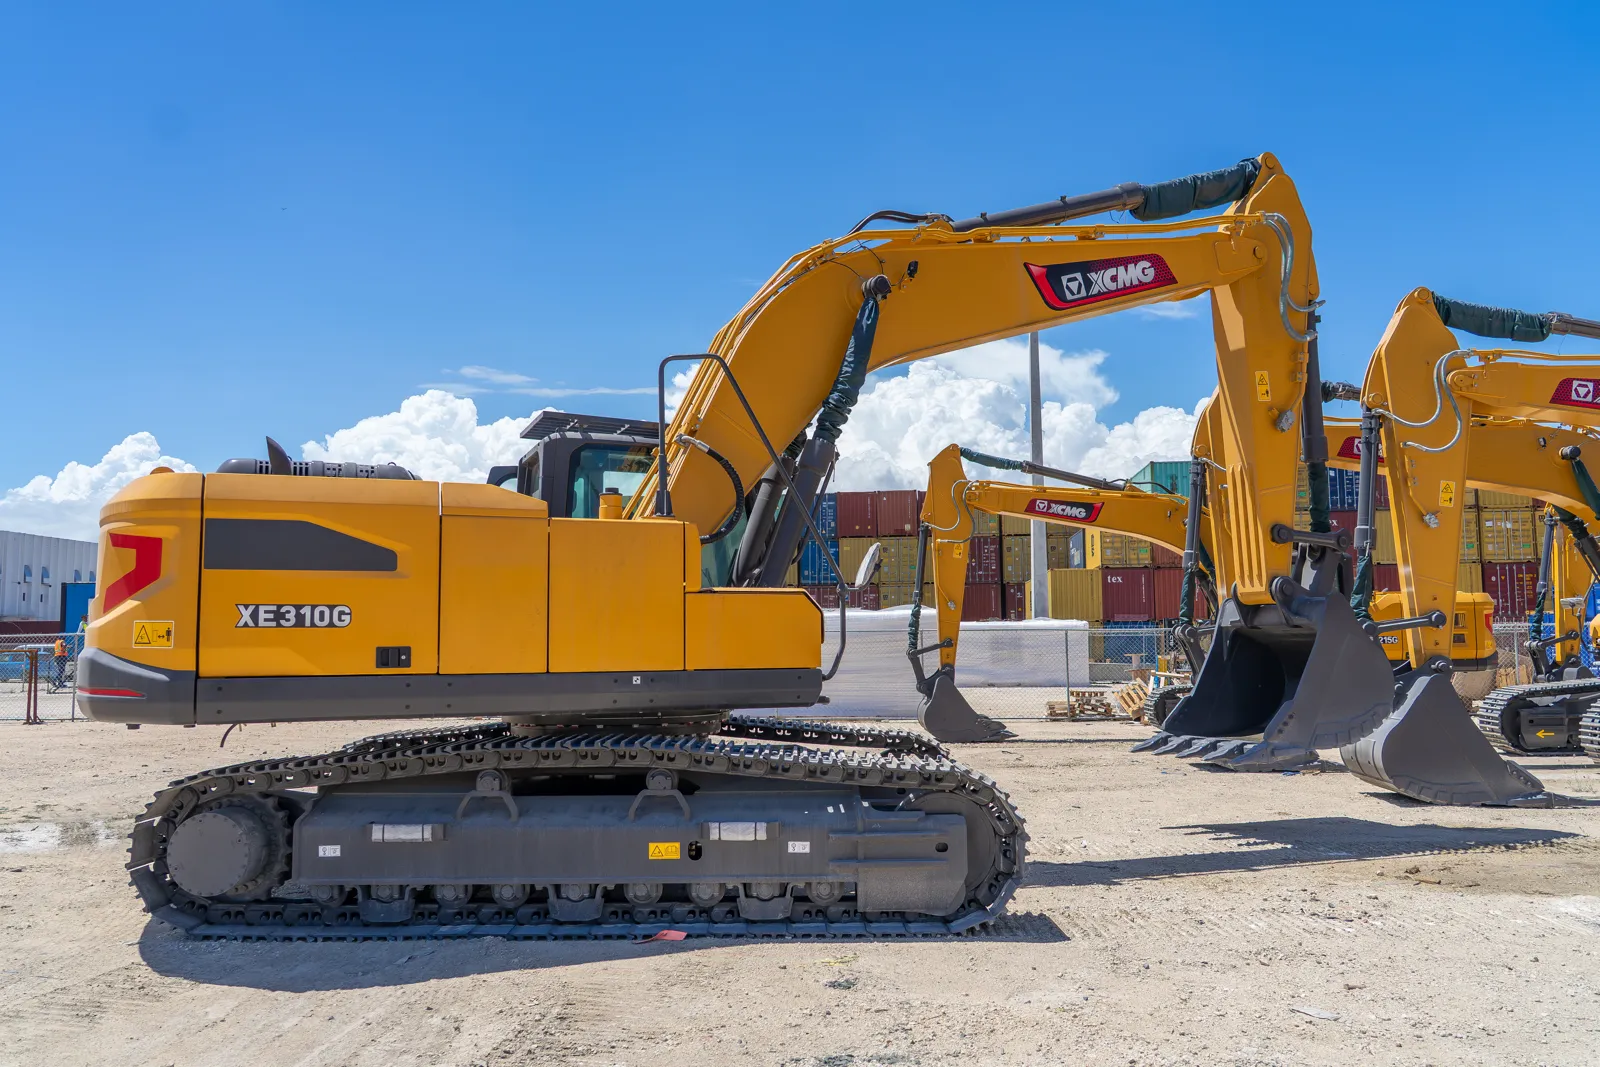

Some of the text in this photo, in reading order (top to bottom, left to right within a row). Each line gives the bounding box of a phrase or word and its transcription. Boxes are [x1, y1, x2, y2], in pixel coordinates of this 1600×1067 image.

[1086, 260, 1155, 297] XCMG
[1047, 502, 1087, 519] XCMG
[1107, 574, 1123, 583] tex
[236, 604, 351, 627] XE310G
